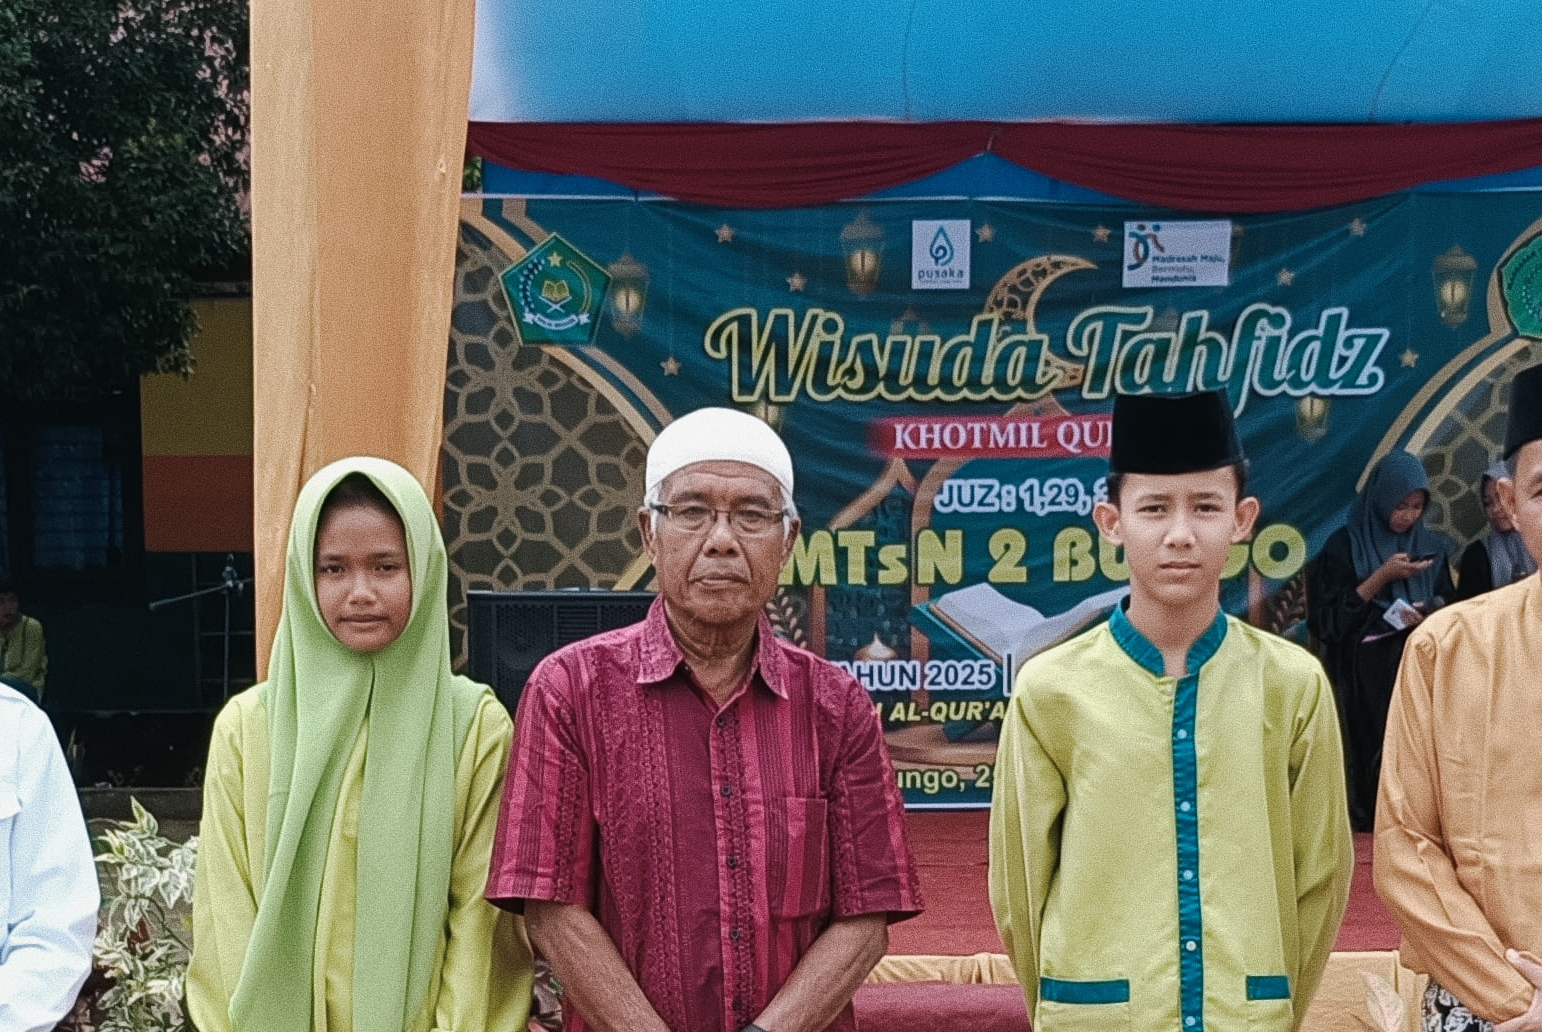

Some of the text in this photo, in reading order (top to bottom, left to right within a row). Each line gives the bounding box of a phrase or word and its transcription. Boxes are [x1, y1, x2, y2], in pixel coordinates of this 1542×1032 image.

[704, 306, 1390, 417] Wisuda Tahfidz
[894, 420, 1113, 453] KHOTMIL QU
[778, 523, 1307, 586] MTsN 2 BUO
[840, 660, 997, 690] HUN 2025
[888, 701, 1008, 724] AL-QUR'A
[973, 763, 997, 789] 2
